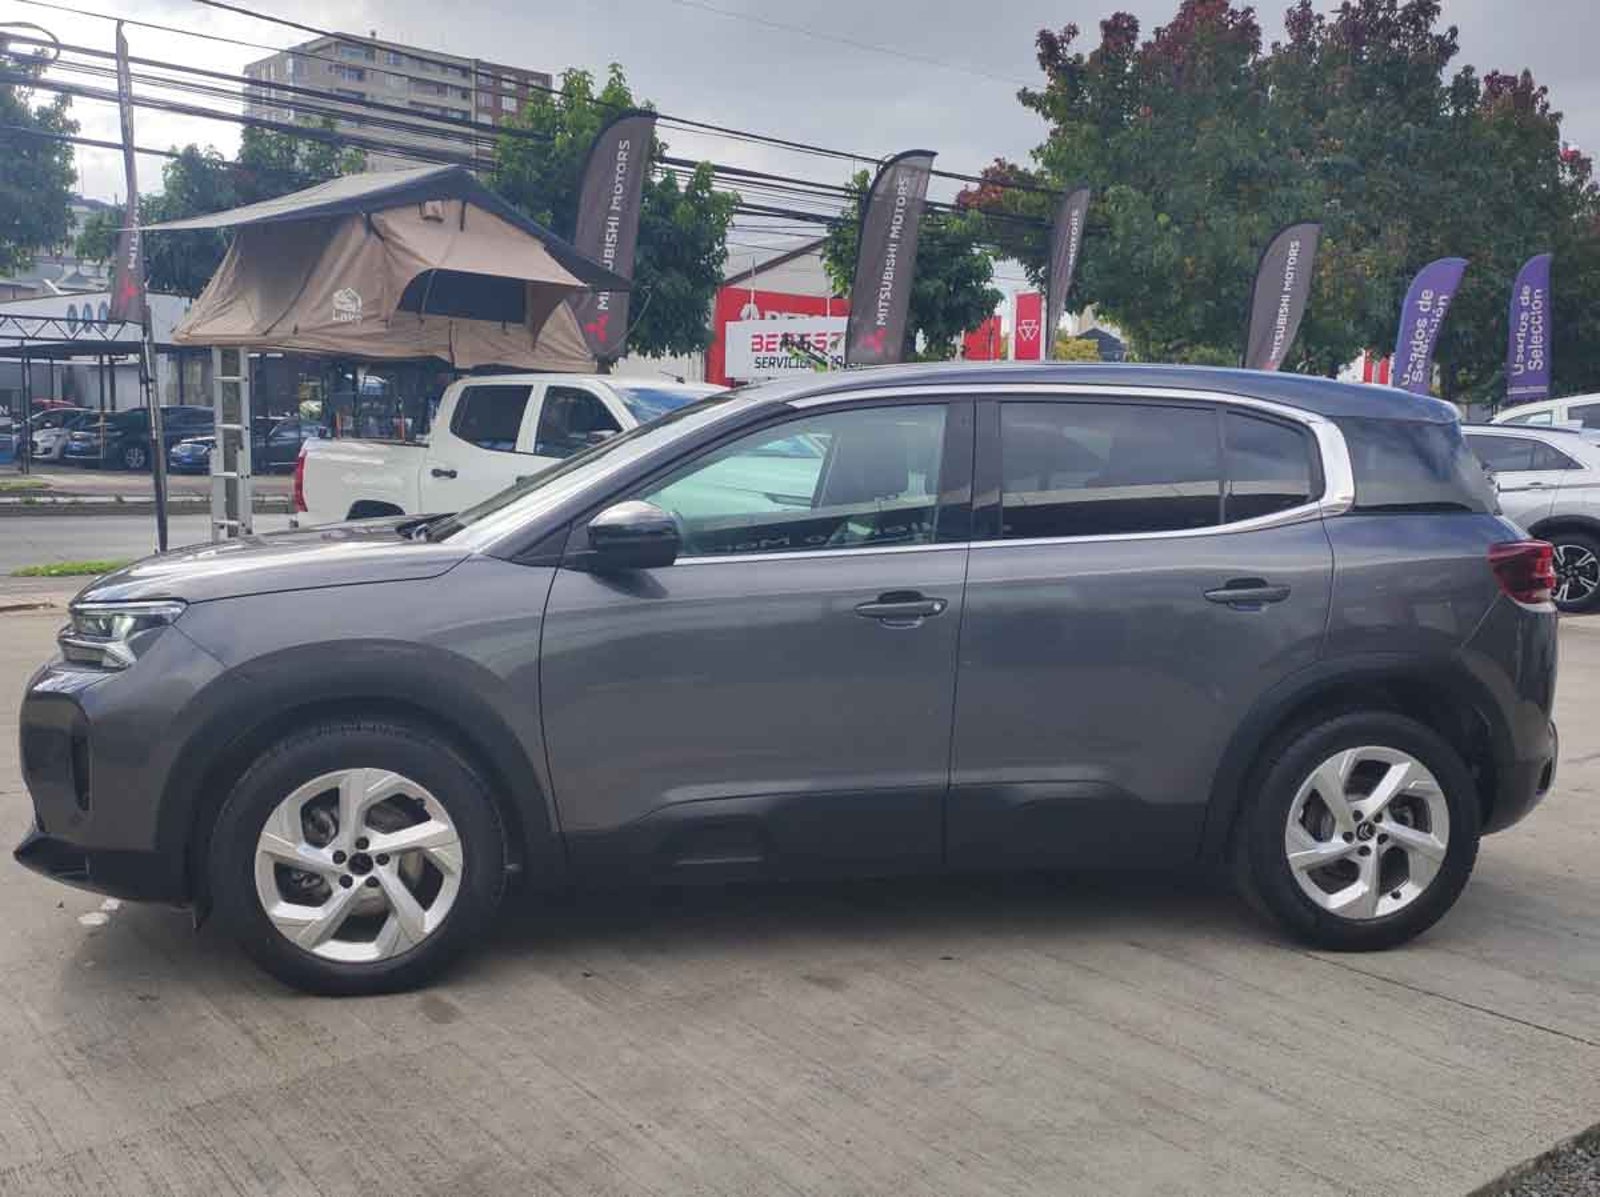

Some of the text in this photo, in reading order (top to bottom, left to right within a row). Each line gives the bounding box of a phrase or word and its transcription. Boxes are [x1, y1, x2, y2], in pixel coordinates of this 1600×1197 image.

[597, 140, 630, 310] MIUBISHI MOTORS
[876, 177, 911, 326] MITSUBISHI MOTORS
[1283, 241, 1300, 291] MOTORS
[1417, 289, 1434, 312] de
[1512, 285, 1531, 376] Usados de
